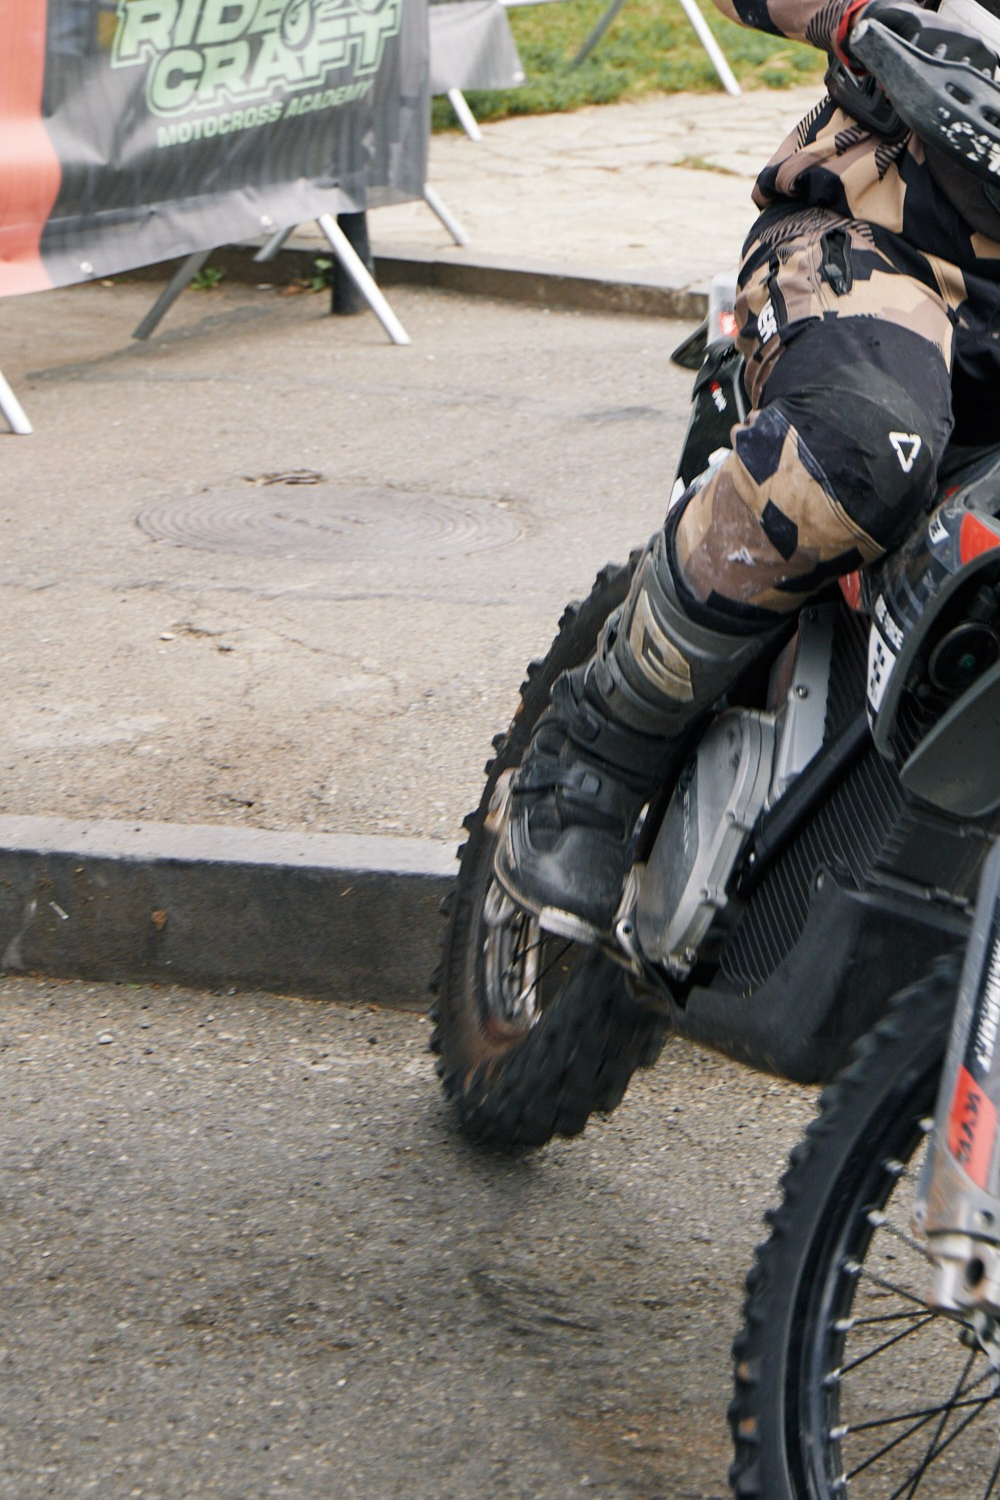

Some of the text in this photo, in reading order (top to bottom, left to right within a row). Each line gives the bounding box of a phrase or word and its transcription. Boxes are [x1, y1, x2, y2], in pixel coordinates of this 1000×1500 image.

[151, 7, 396, 109] CRAFT
[156, 77, 376, 149] MOTOCROSS ACADEMY
